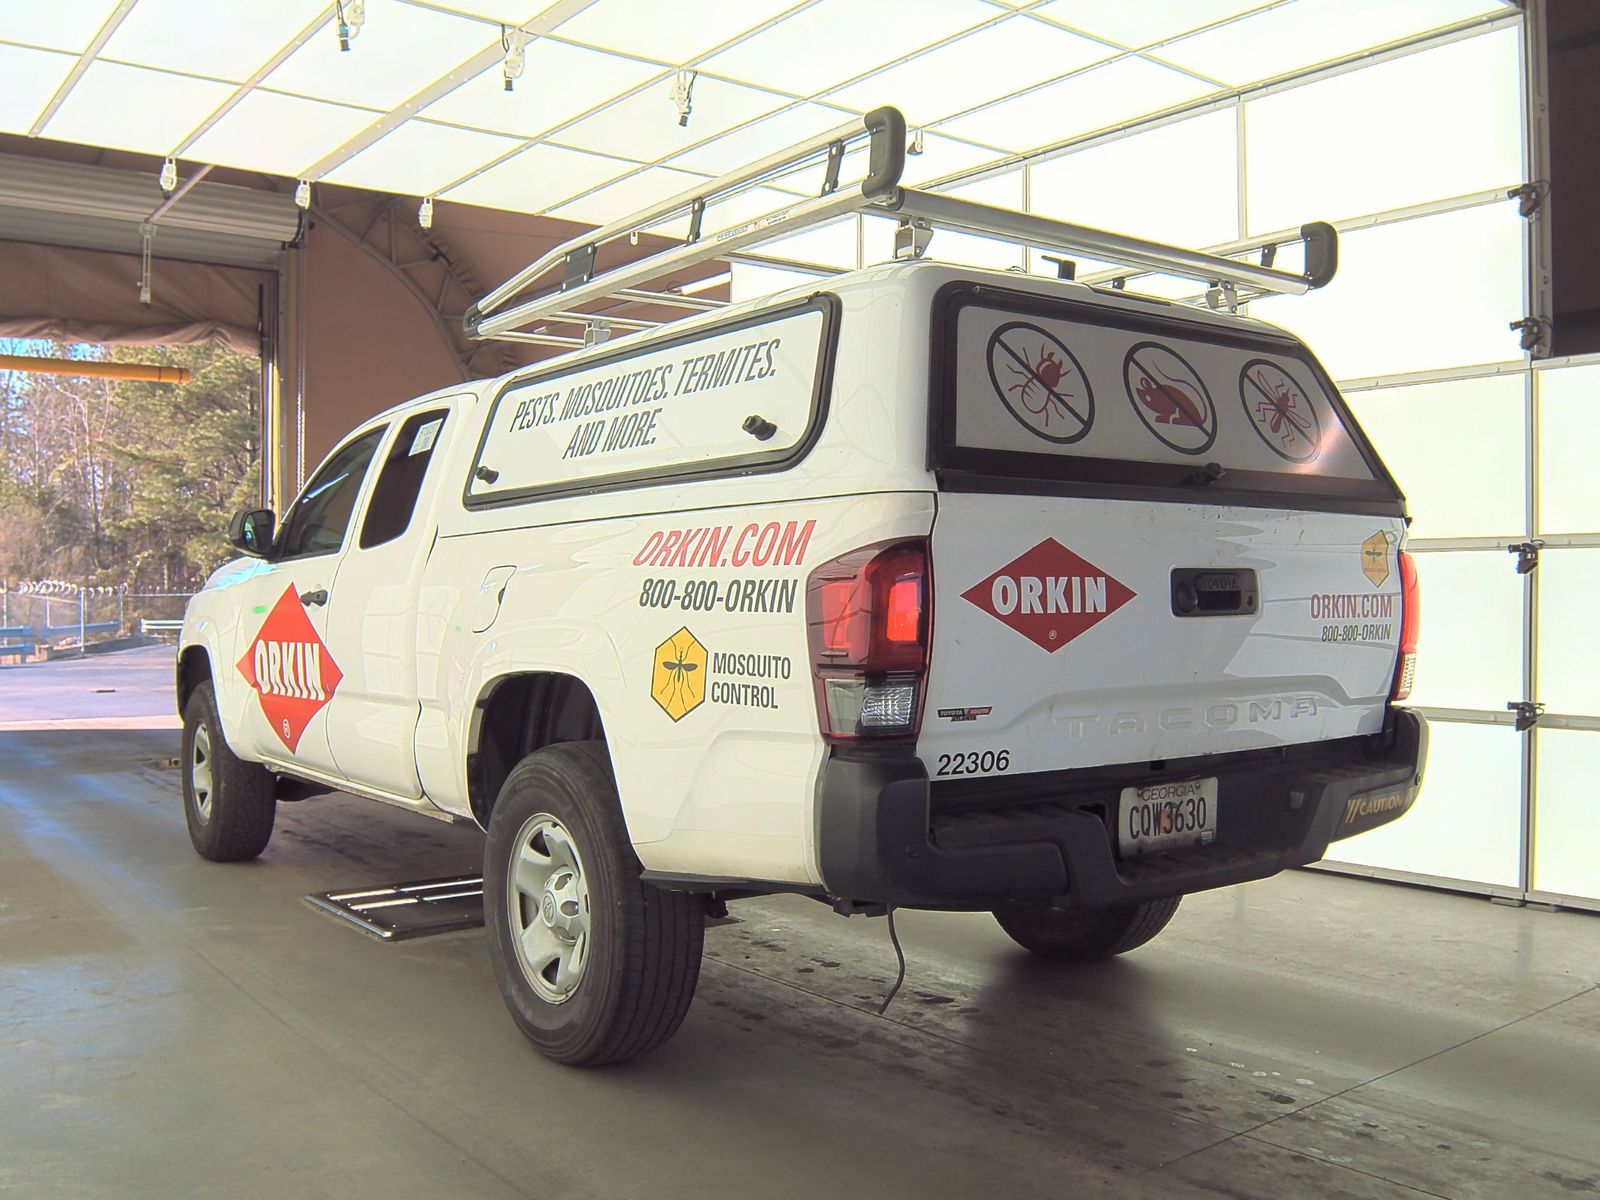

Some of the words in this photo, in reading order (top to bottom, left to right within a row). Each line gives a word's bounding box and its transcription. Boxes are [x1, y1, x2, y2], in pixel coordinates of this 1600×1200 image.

[509, 391, 560, 432] PESTS.
[558, 363, 673, 421] MOSQUITOES.
[673, 338, 781, 397] TERMITES.
[562, 421, 606, 460] AND
[602, 407, 663, 453] MORE.
[632, 519, 817, 568] ORKIN.COM
[639, 578, 798, 613] 800-800-ORKIN
[991, 575, 1107, 616] ORKIN
[1310, 593, 1393, 619] ORKIN.COM
[1321, 623, 1392, 643] 800-800-ORKIN
[254, 638, 326, 702] ORKIN
[712, 652, 791, 680] MOSQUITO
[711, 681, 779, 709] CONTROL
[1053, 698, 1319, 738] TACOMA
[936, 749, 1010, 776] 22306
[1141, 784, 1196, 802] GEORGIA
[1359, 794, 1405, 817] CAUTION
[1129, 797, 1207, 840] CQW3630
